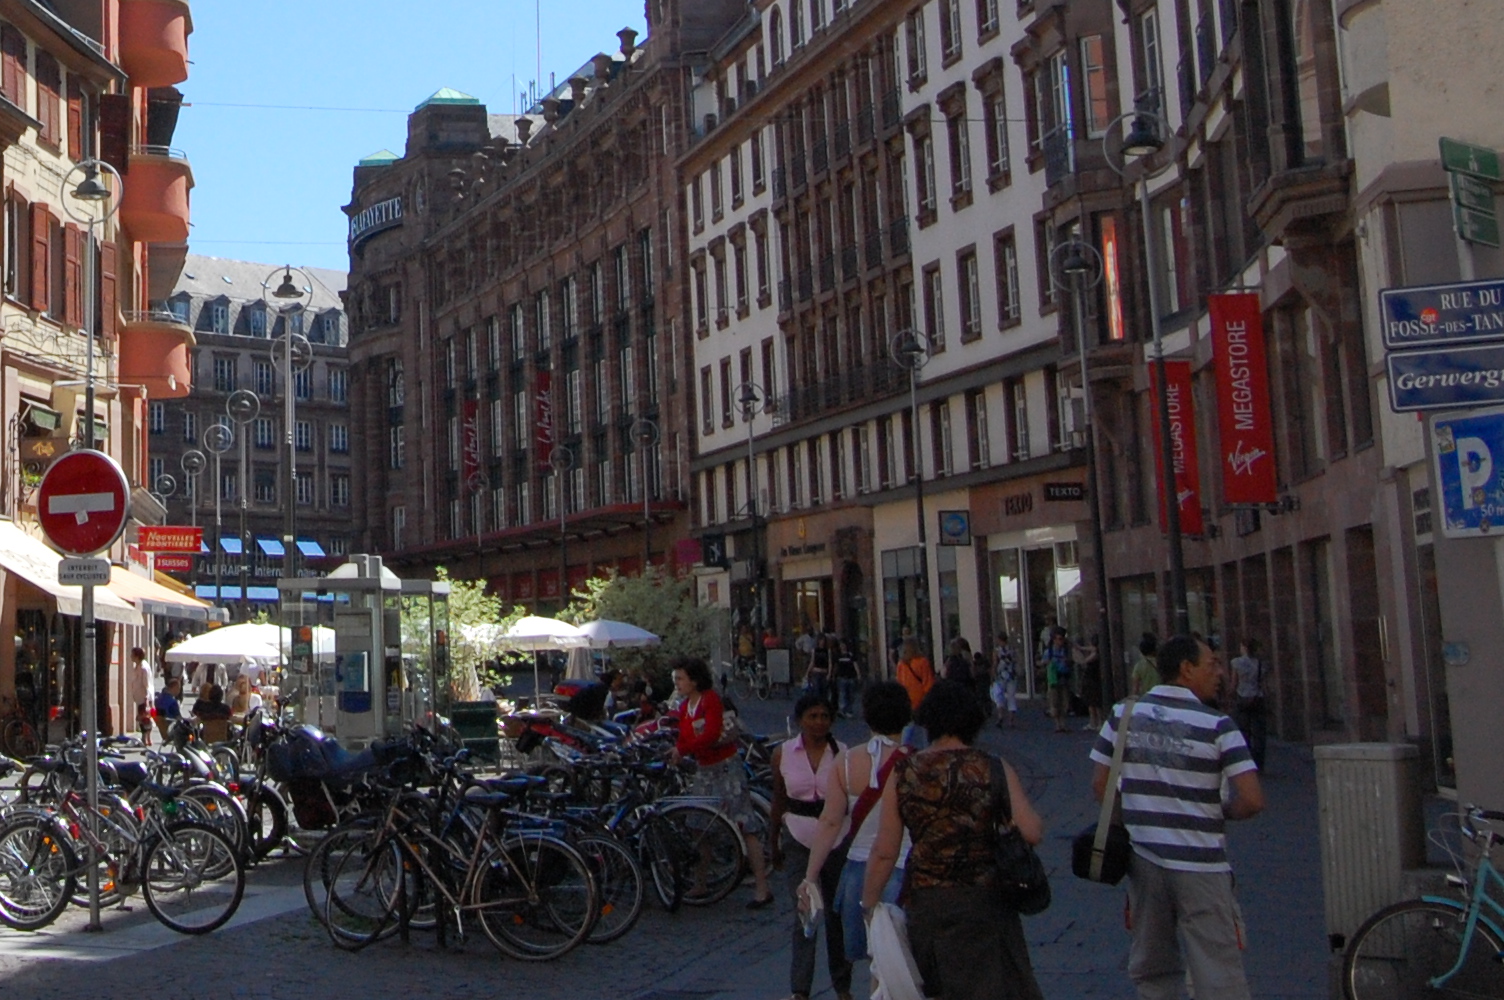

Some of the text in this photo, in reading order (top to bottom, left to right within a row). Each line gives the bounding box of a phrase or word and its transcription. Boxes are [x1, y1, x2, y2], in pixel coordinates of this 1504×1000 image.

[1440, 288, 1502, 310] RUE DU
[1226, 320, 1254, 430] MEGASTORE
[1228, 440, 1265, 475] Virgin
[1050, 487, 1080, 496] TEXTO
[1005, 492, 1033, 516] TEXTO
[76, 572, 108, 580] CYCLISTES
